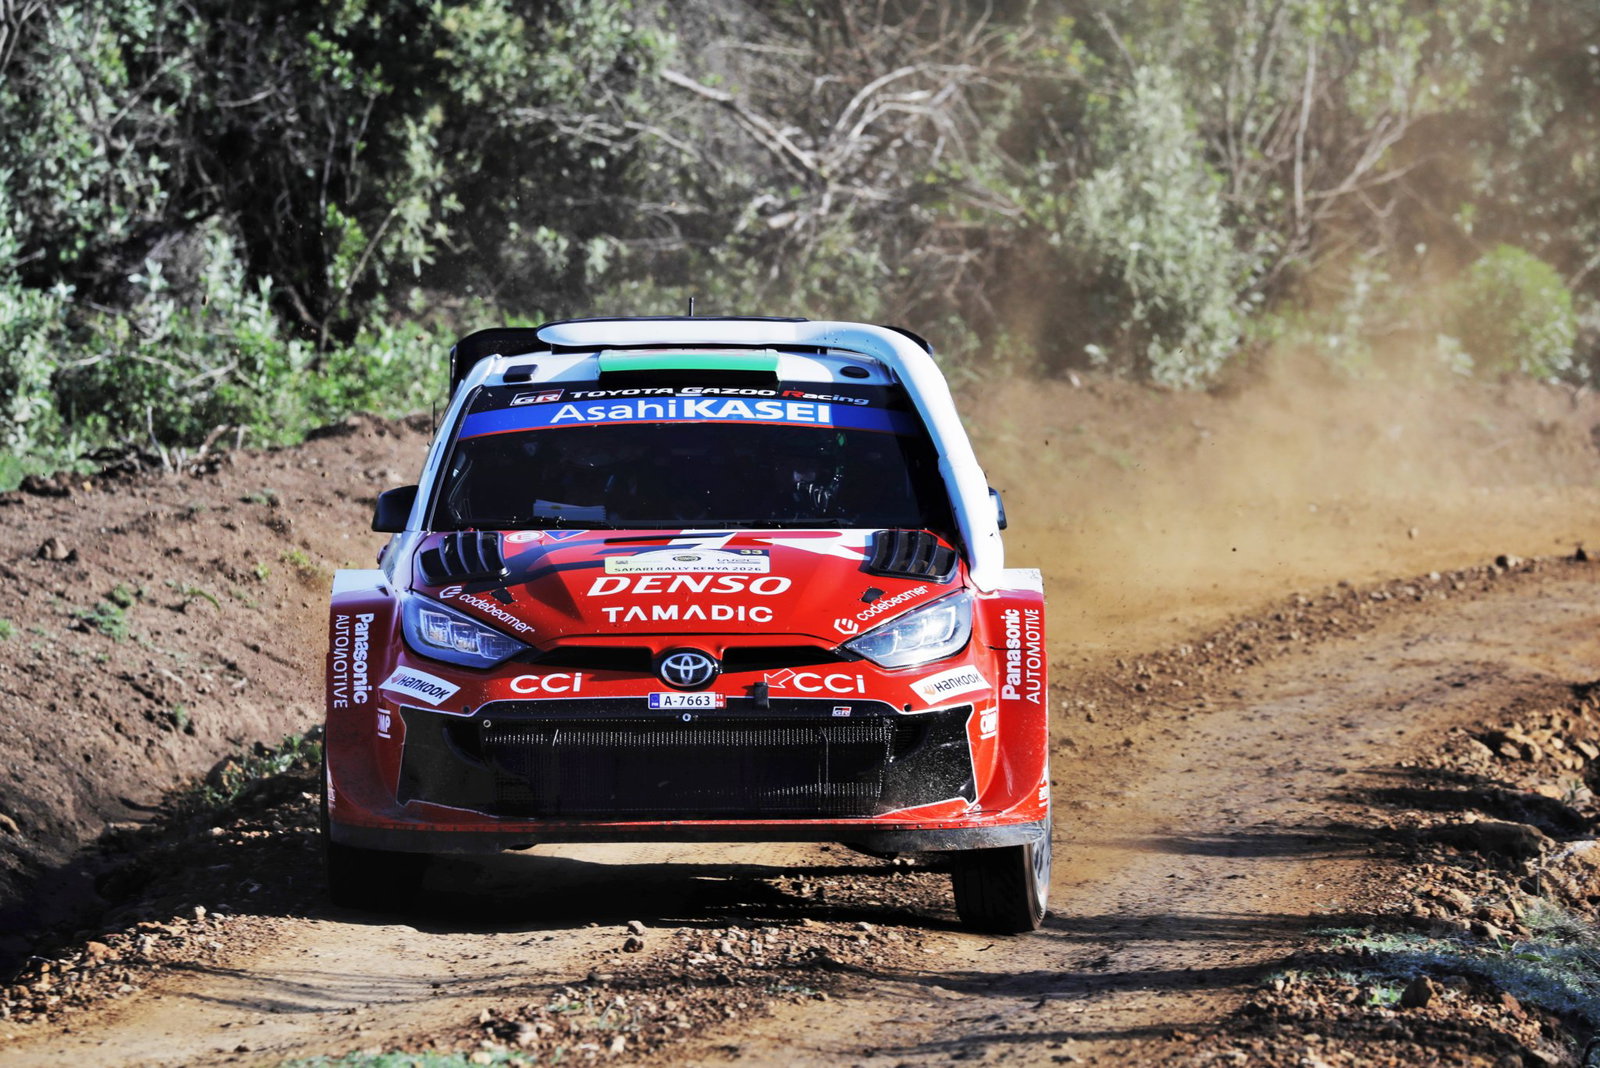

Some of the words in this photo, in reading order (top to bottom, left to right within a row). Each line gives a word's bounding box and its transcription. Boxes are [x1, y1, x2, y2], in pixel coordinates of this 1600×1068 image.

[513, 392, 560, 406] GR
[550, 400, 676, 423] Asahi
[683, 399, 830, 423] KASEI
[570, 387, 674, 398] TOYOTA
[676, 386, 775, 397] GAZOO
[781, 390, 870, 406] Racing
[587, 575, 793, 597] DENSO
[459, 594, 535, 633] codebeamer
[602, 605, 774, 623] TAMADIC
[857, 585, 929, 621] codebeamer
[333, 614, 350, 709] AUTOMOTIVE
[353, 613, 375, 704] Panasonic
[1000, 609, 1022, 700] Panasonic
[1024, 608, 1041, 705] AUTOMOTIVE
[664, 695, 711, 706] A-7663
